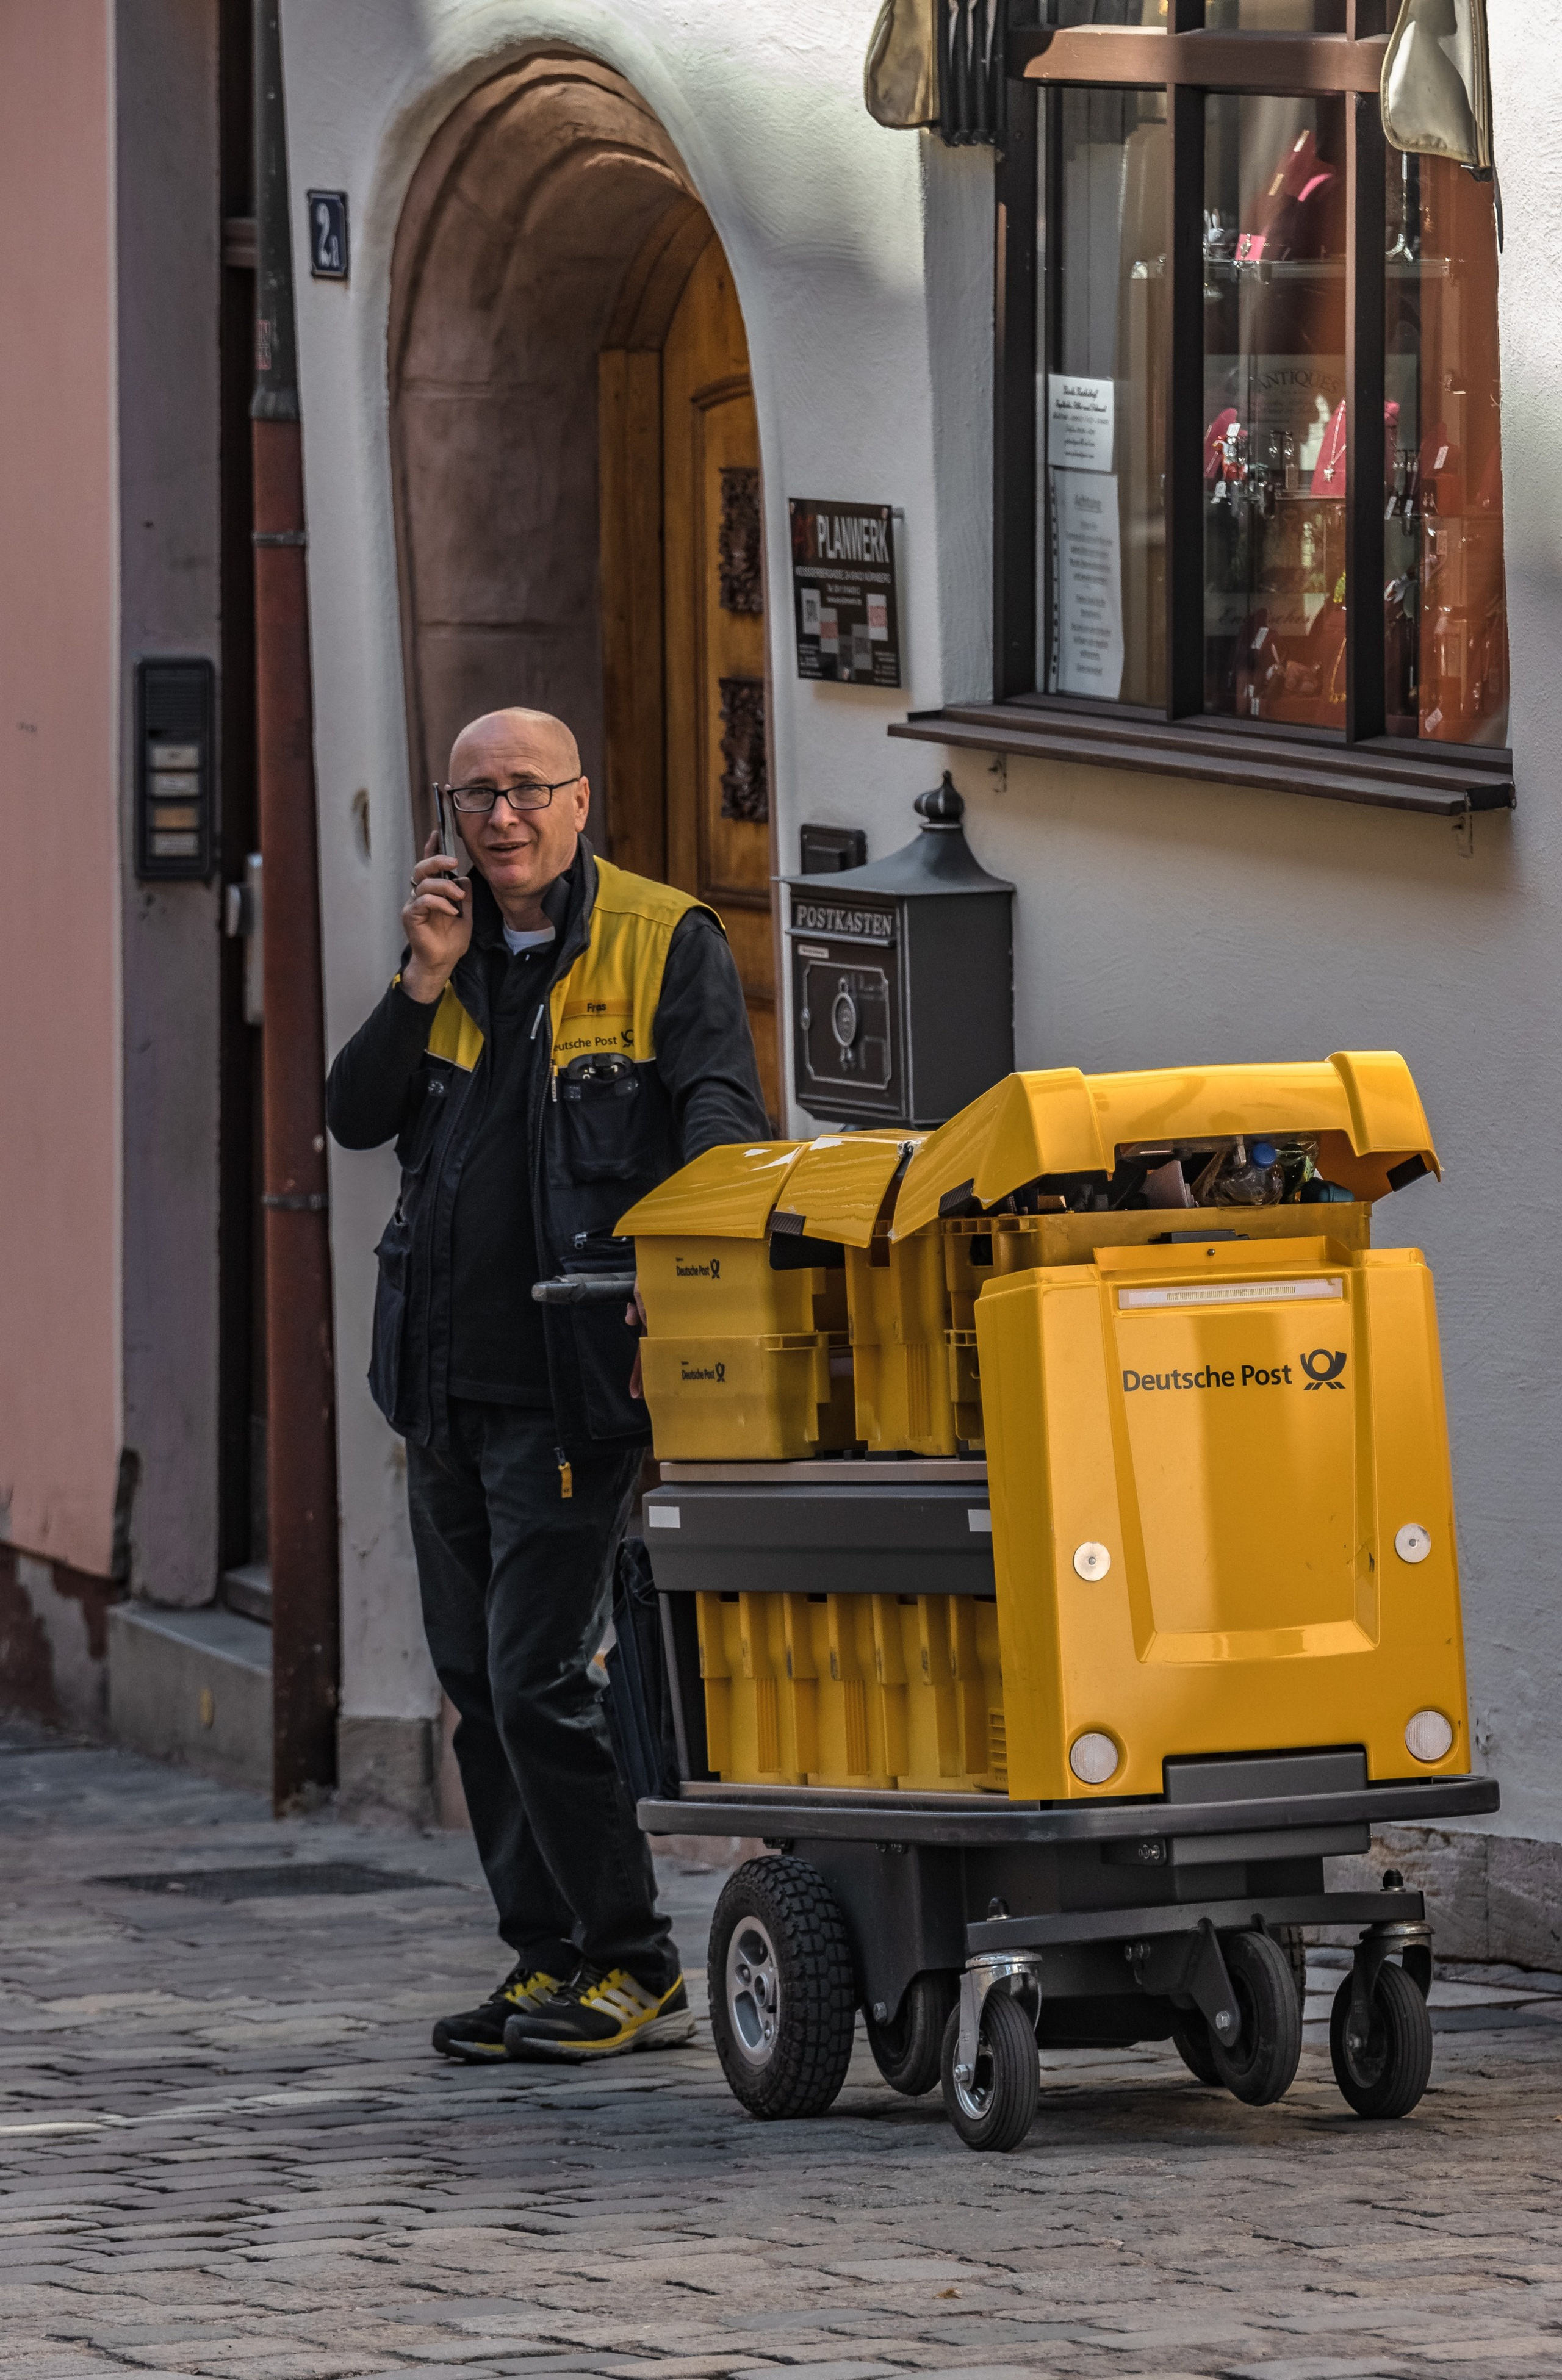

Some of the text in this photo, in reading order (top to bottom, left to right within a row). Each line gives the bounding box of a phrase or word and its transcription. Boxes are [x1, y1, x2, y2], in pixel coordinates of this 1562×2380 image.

[816, 514, 890, 564] PLANWERK
[796, 905, 893, 936] POSTKASTEN
[553, 1037, 617, 1052] eutsche Post
[676, 1265, 710, 1276] Deutsche Post
[682, 1368, 714, 1379] Deutsche Post
[1123, 1364, 1293, 1392] Deutsche Post
